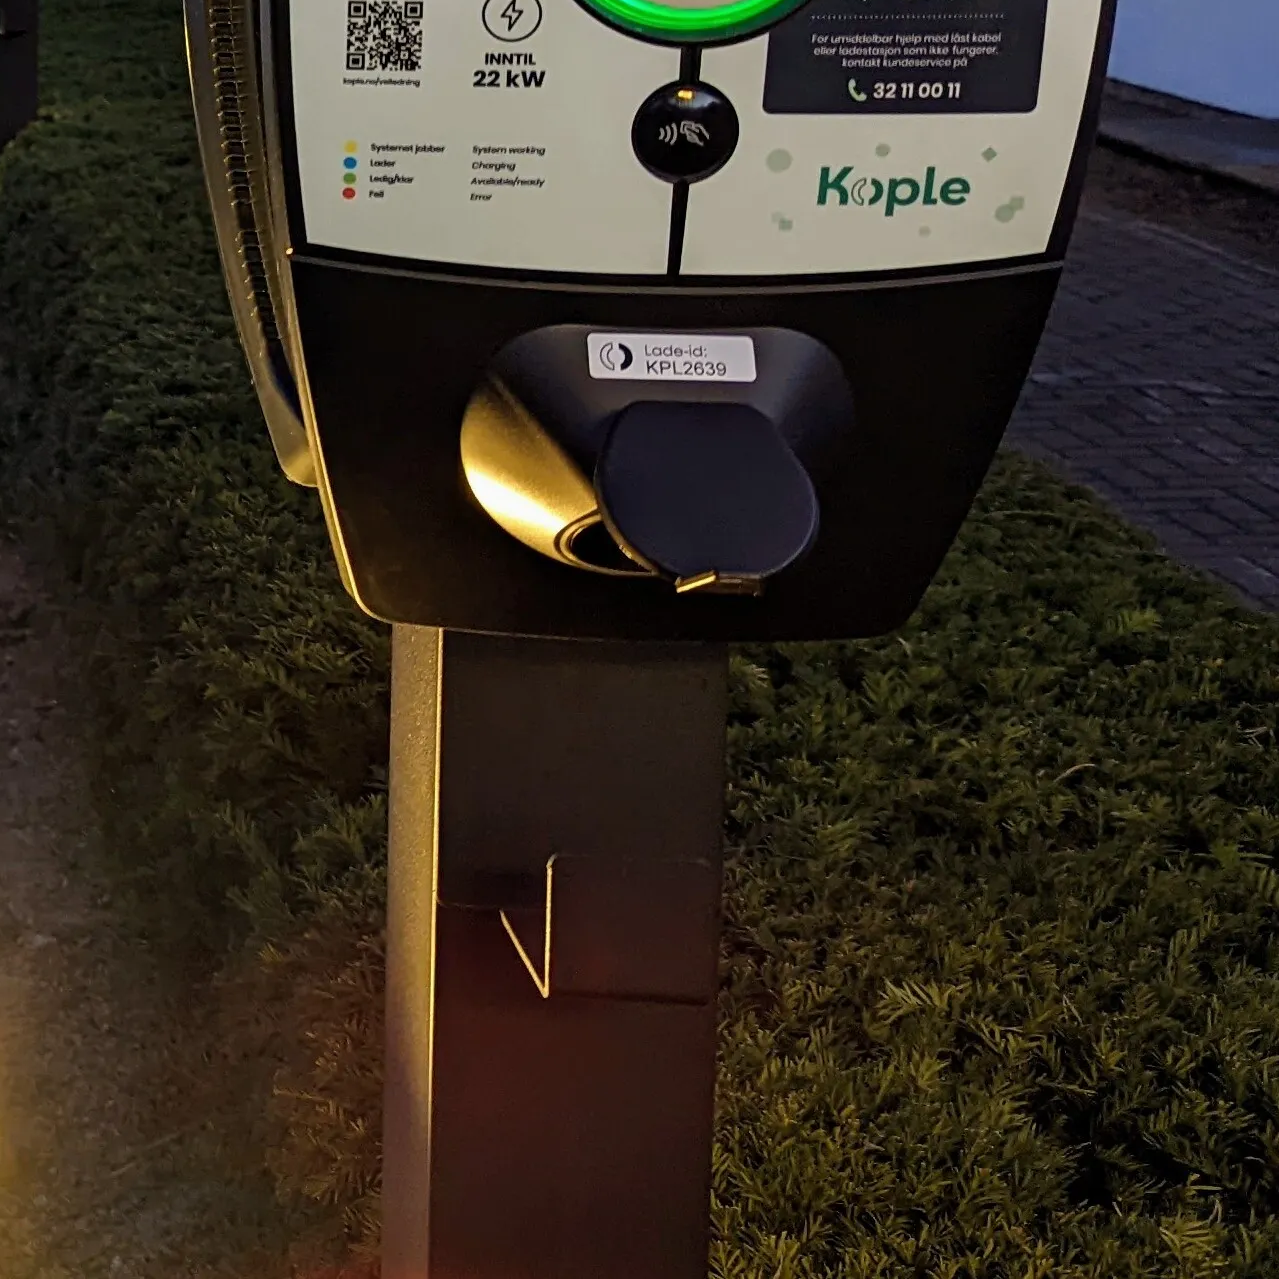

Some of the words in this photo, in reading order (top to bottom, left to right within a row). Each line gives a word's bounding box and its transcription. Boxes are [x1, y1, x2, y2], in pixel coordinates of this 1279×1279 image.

[924, 33, 948, 43] med
[972, 32, 1001, 42] kabel
[903, 47, 927, 55] som
[485, 52, 536, 65] INNTIL
[842, 58, 881, 68] kontakt
[883, 58, 951, 67] kundeservice
[953, 57, 968, 69] på
[473, 70, 500, 88] 22
[506, 69, 545, 88] kW
[873, 82, 897, 99] 32
[901, 82, 914, 98] 11
[918, 82, 943, 98] 00
[947, 82, 961, 98] 11
[817, 166, 971, 217] Kople
[646, 361, 727, 376] KPL2639
